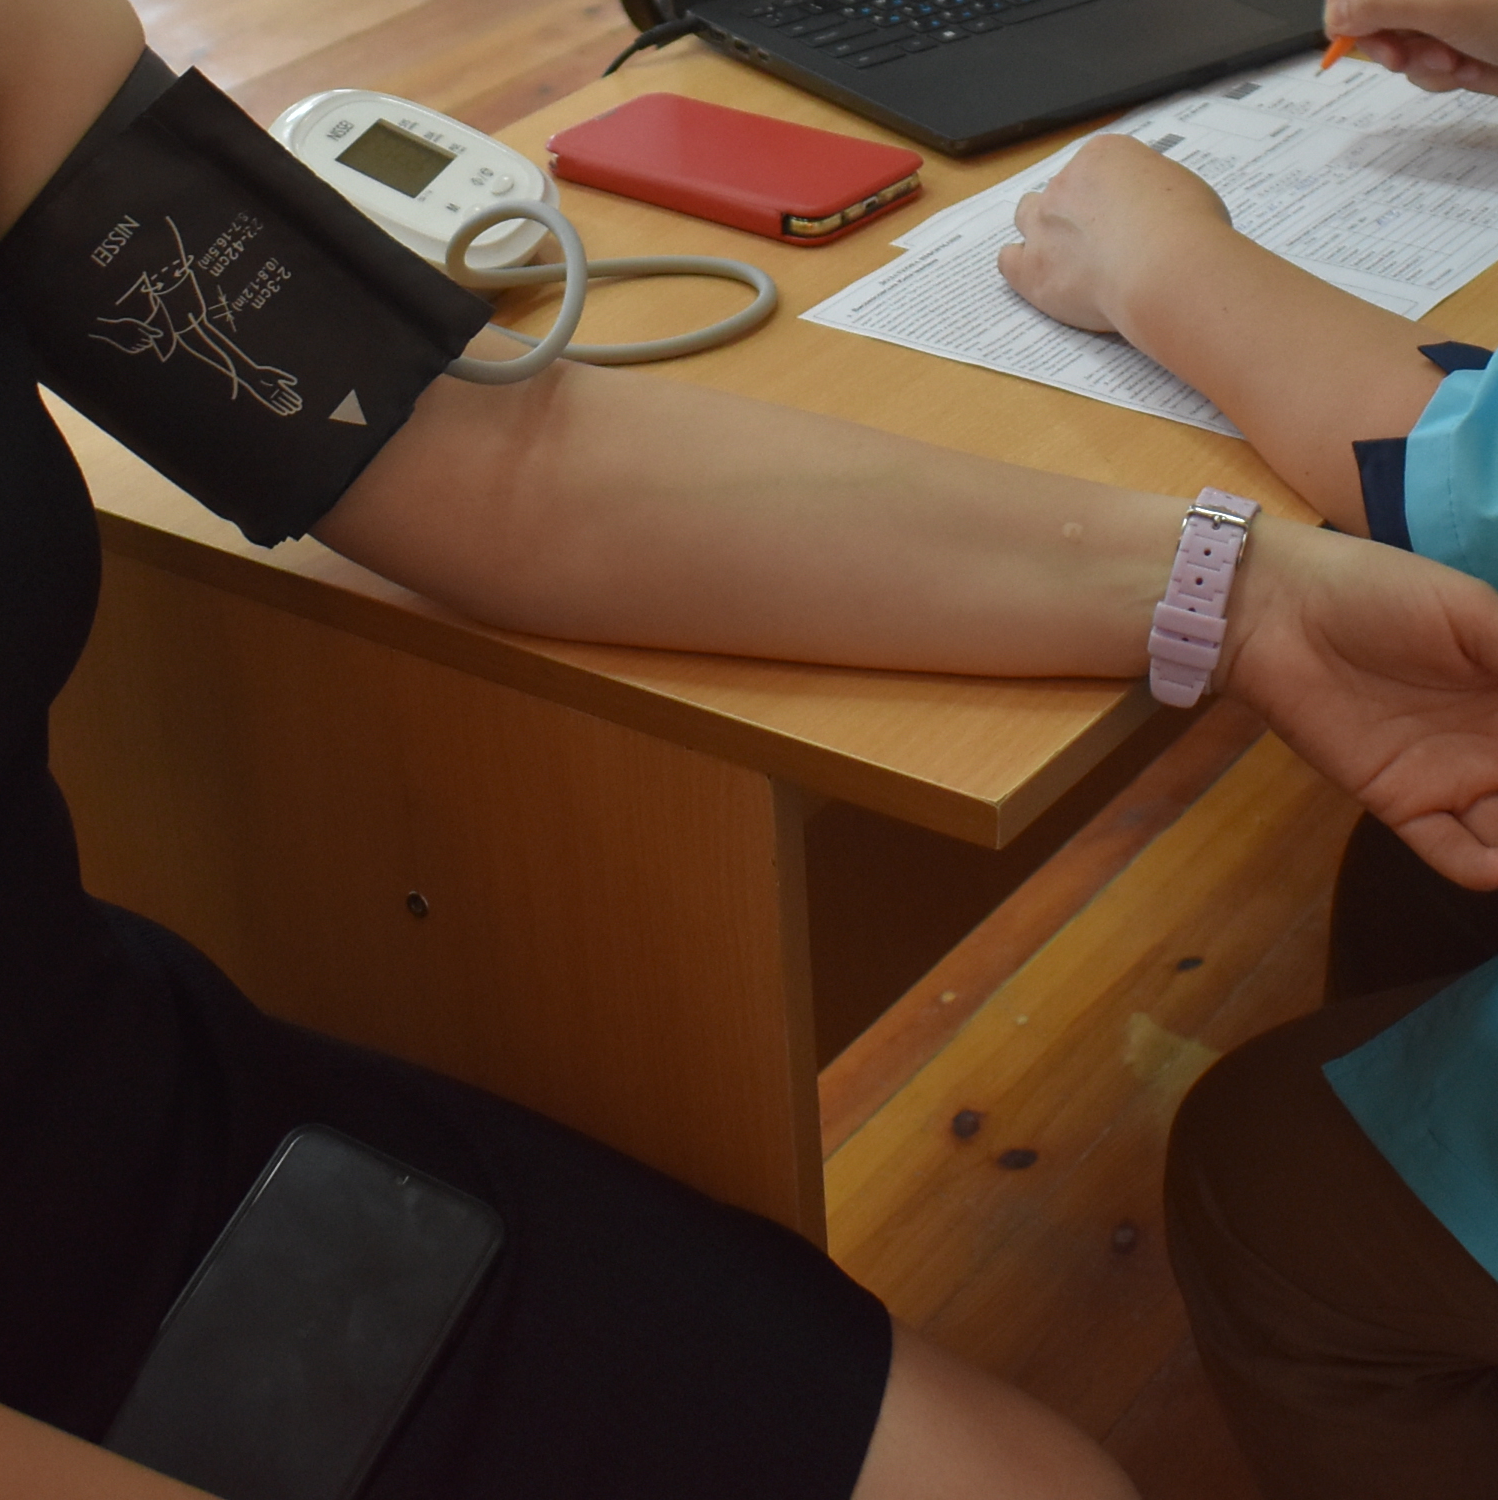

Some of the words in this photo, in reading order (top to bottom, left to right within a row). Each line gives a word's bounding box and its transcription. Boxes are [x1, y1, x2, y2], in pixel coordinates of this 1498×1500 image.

[326, 119, 355, 142] NISSEI
[90, 214, 141, 267] NISSEI
[250, 265, 292, 310] 2-3cm
